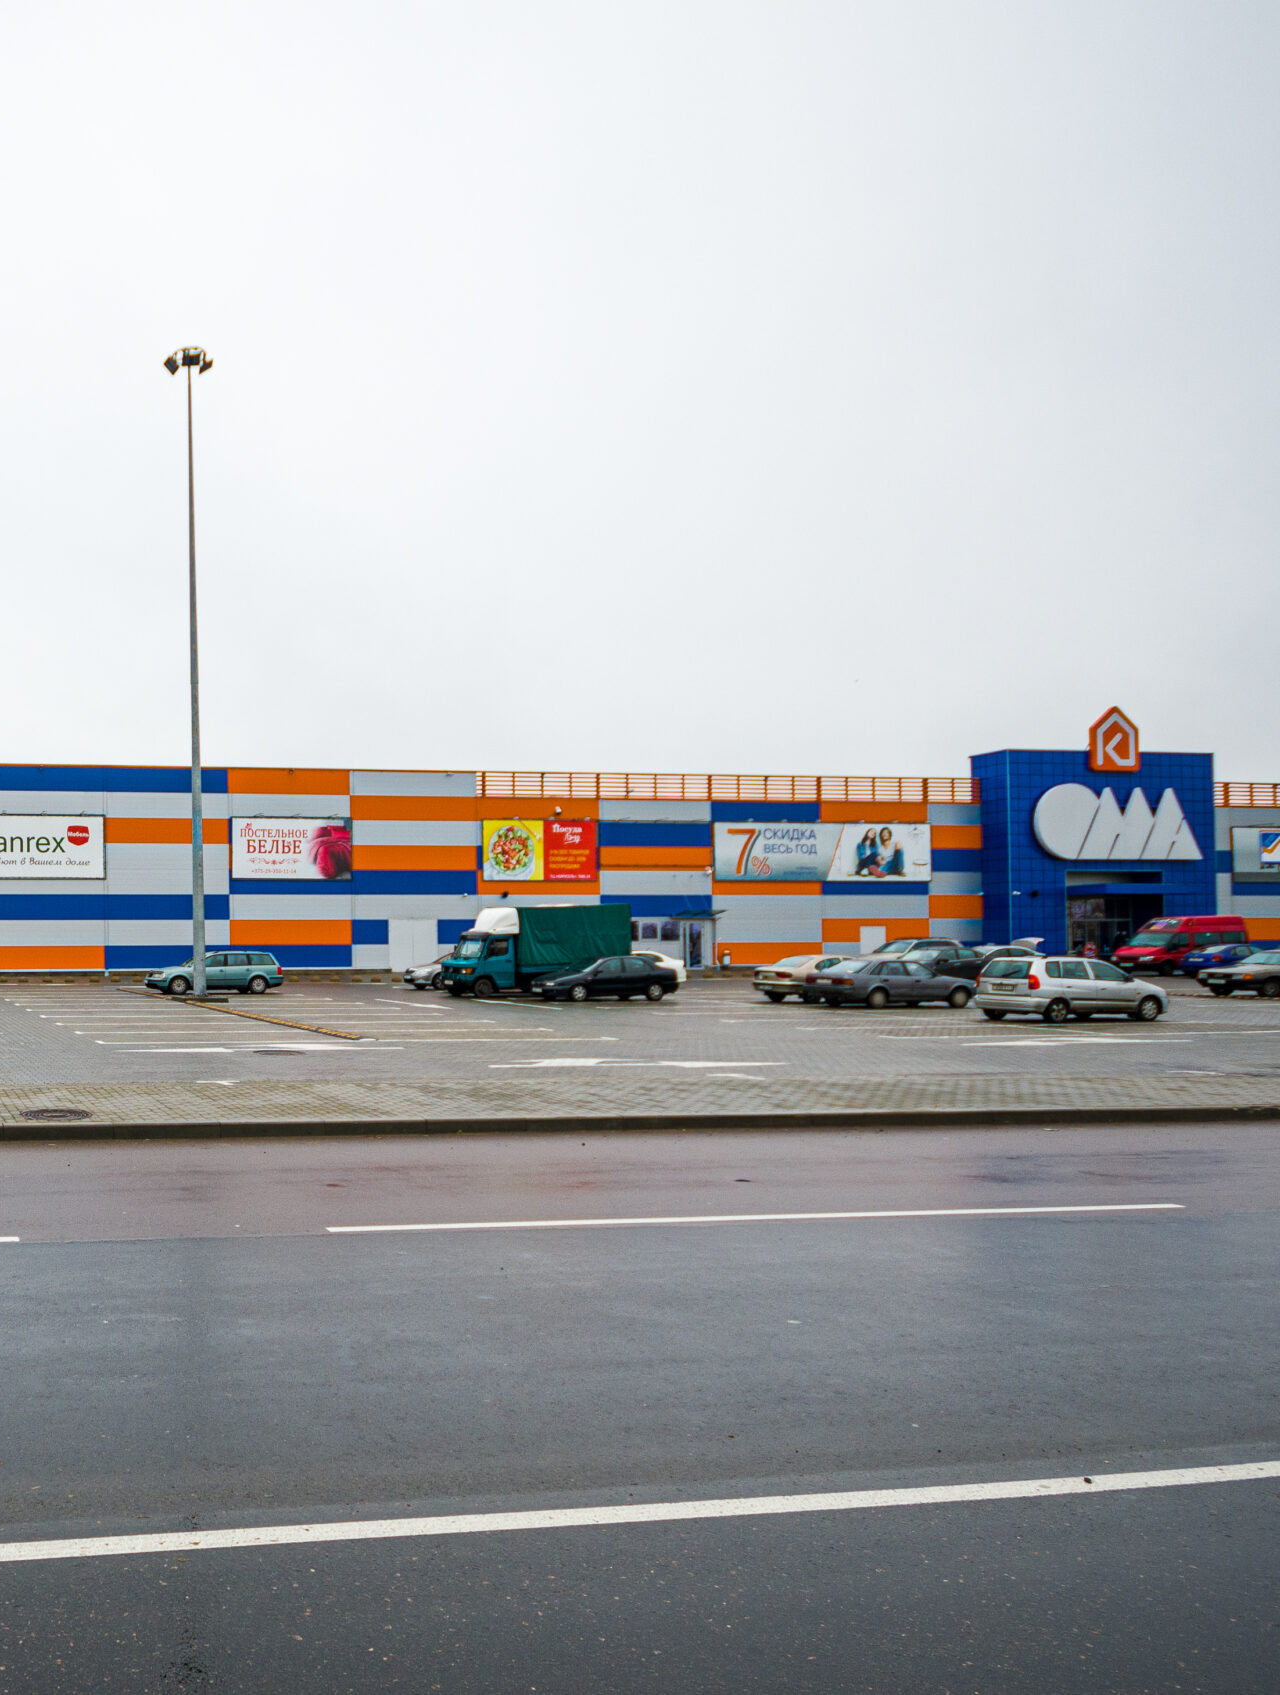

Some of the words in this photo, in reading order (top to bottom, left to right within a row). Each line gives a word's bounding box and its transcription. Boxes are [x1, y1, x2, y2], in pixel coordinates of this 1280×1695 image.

[240, 828, 308, 839] ПОСТЕЛЬНОЕ
[552, 823, 583, 833] Посуда
[763, 828, 817, 842] СКИДКА
[246, 839, 302, 855] БЕЛЬЕ
[763, 844, 793, 854] ВЕСЬ
[795, 844, 818, 855] ГОД
[65, 858, 91, 866] доме
